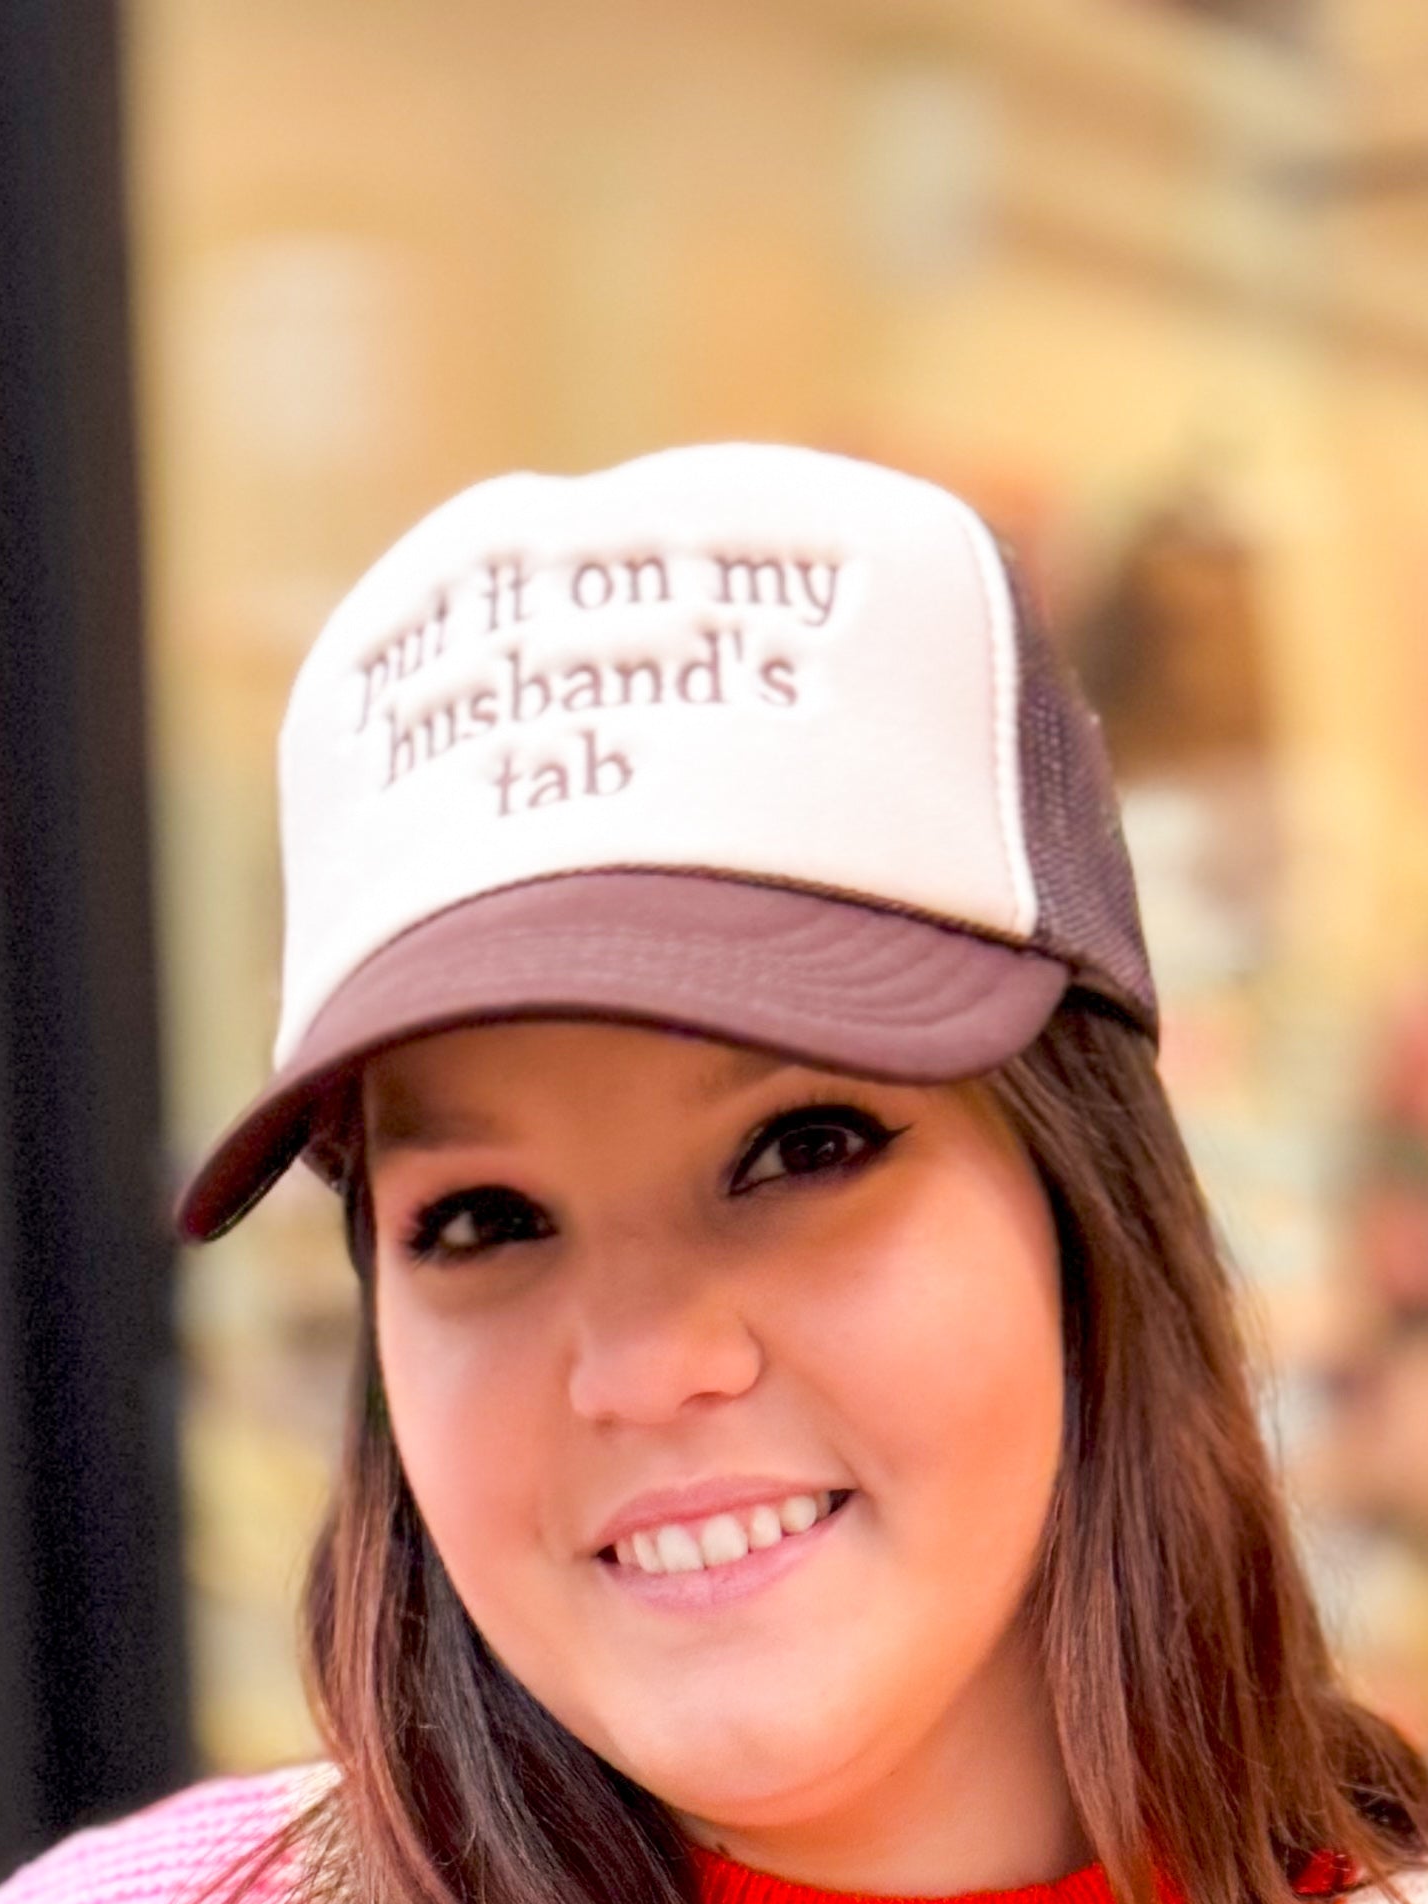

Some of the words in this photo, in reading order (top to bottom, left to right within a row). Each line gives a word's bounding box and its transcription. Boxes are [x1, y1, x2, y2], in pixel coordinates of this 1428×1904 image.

[353, 586, 452, 735] put
[482, 556, 532, 634] it
[569, 556, 673, 610] on
[710, 553, 840, 628] my
[383, 628, 800, 790] husband's
[494, 728, 634, 819] tab
